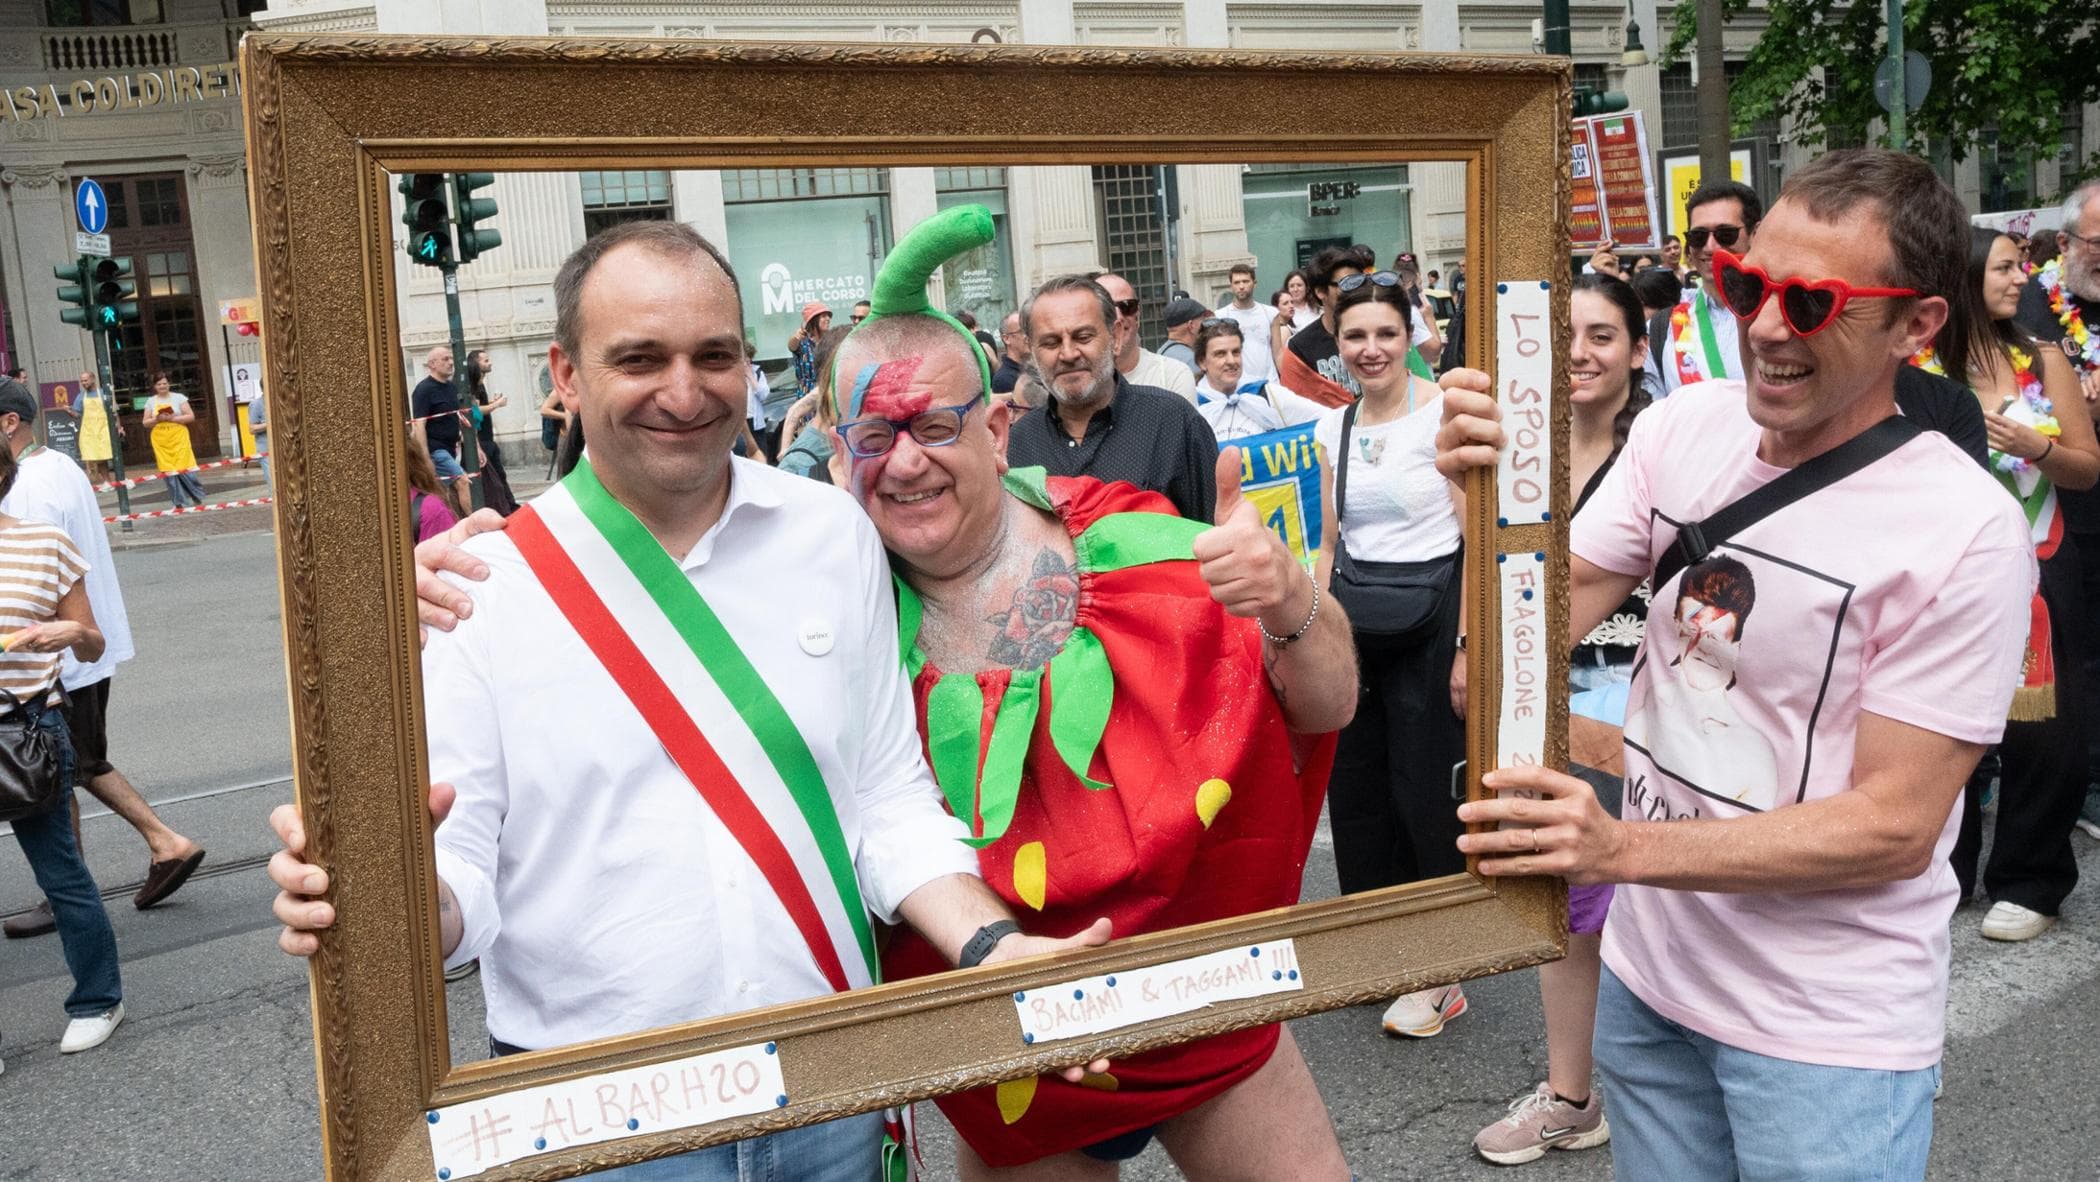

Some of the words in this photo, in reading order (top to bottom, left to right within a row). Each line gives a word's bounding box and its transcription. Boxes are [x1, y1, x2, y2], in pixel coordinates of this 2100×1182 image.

[793, 275, 864, 291] MERCATO
[795, 291, 819, 304] DEL
[822, 287, 865, 301] CORSO
[1510, 313, 1540, 358] LO
[1508, 379, 1544, 504] SPOSO
[1030, 987, 1124, 1032] BACIAMI
[1141, 978, 1161, 1002] &
[1164, 956, 1263, 1001] TAGGAMI
